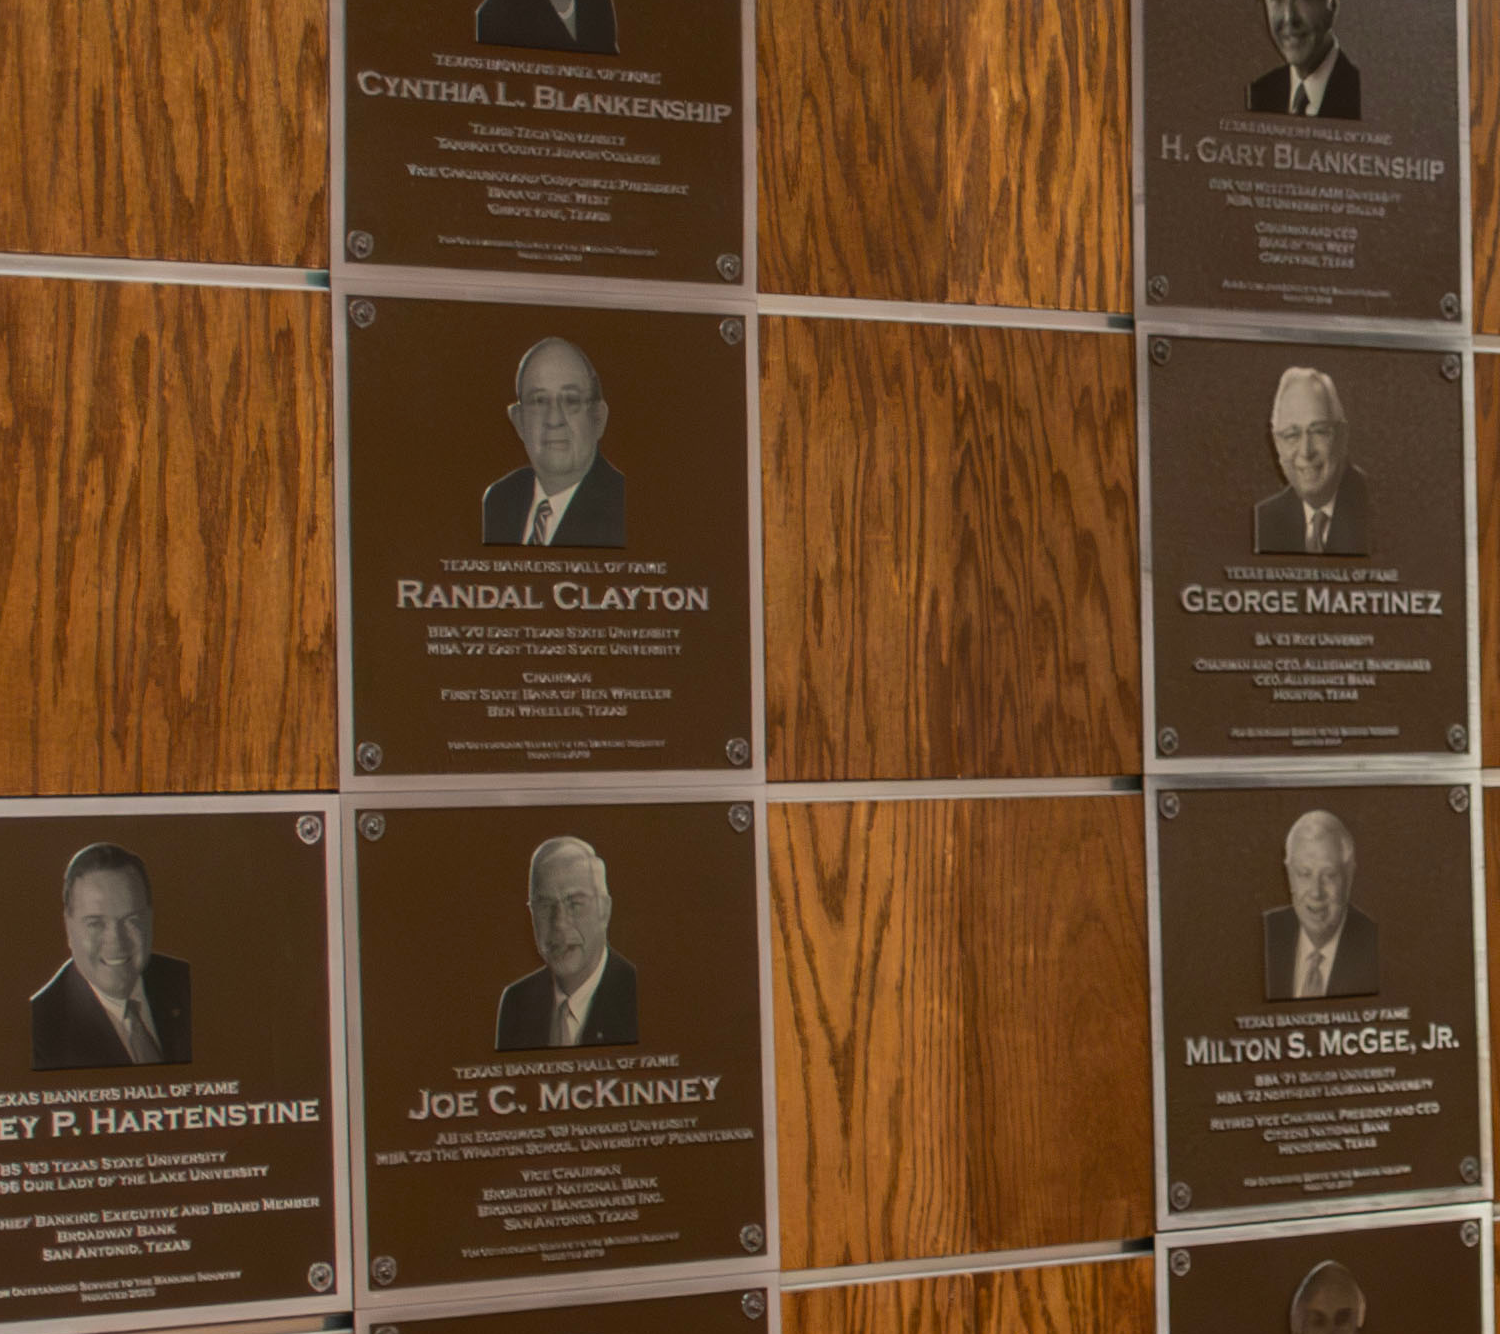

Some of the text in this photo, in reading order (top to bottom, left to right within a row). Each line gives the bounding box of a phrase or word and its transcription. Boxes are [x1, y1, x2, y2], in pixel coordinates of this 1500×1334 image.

[357, 71, 732, 123] CYNTHIA L. BLANKENSHIP
[1162, 135, 1444, 181] H. GARY BLANKENSHIP
[397, 580, 708, 610] RANDAL CLAYTON
[1182, 585, 1442, 614] GEORGE MARTINEZ
[409, 1076, 720, 1119] JOE C. MCKINNEY
[52, 1111, 80, 1137] P.
[91, 1099, 319, 1134] HARTENSTINE
